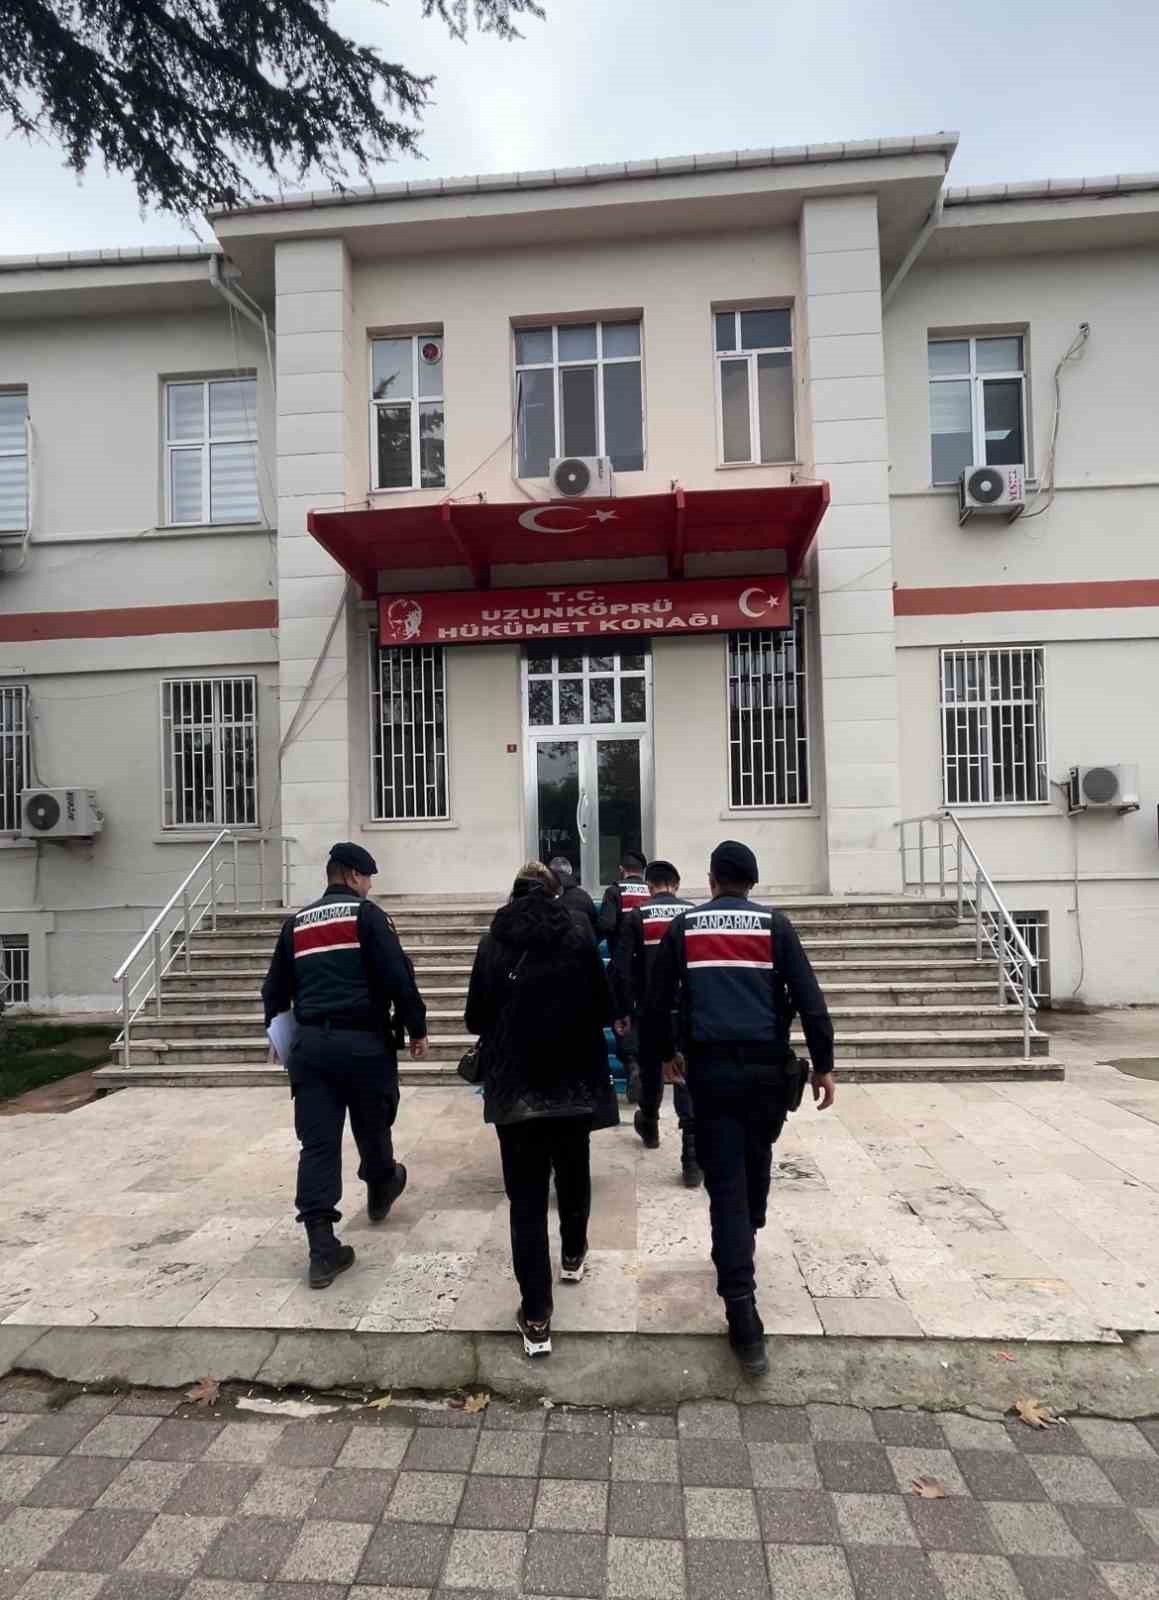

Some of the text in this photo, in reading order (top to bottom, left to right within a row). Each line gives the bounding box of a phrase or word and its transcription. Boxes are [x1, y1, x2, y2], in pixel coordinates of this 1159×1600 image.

[546, 590, 605, 603] T.C.
[480, 599, 673, 621] UZUNKÖPRÜ
[437, 613, 719, 639] HÜKÜMET KONAĞI
[301, 906, 351, 926] JANDARMA
[692, 915, 762, 929] JANDARMA
